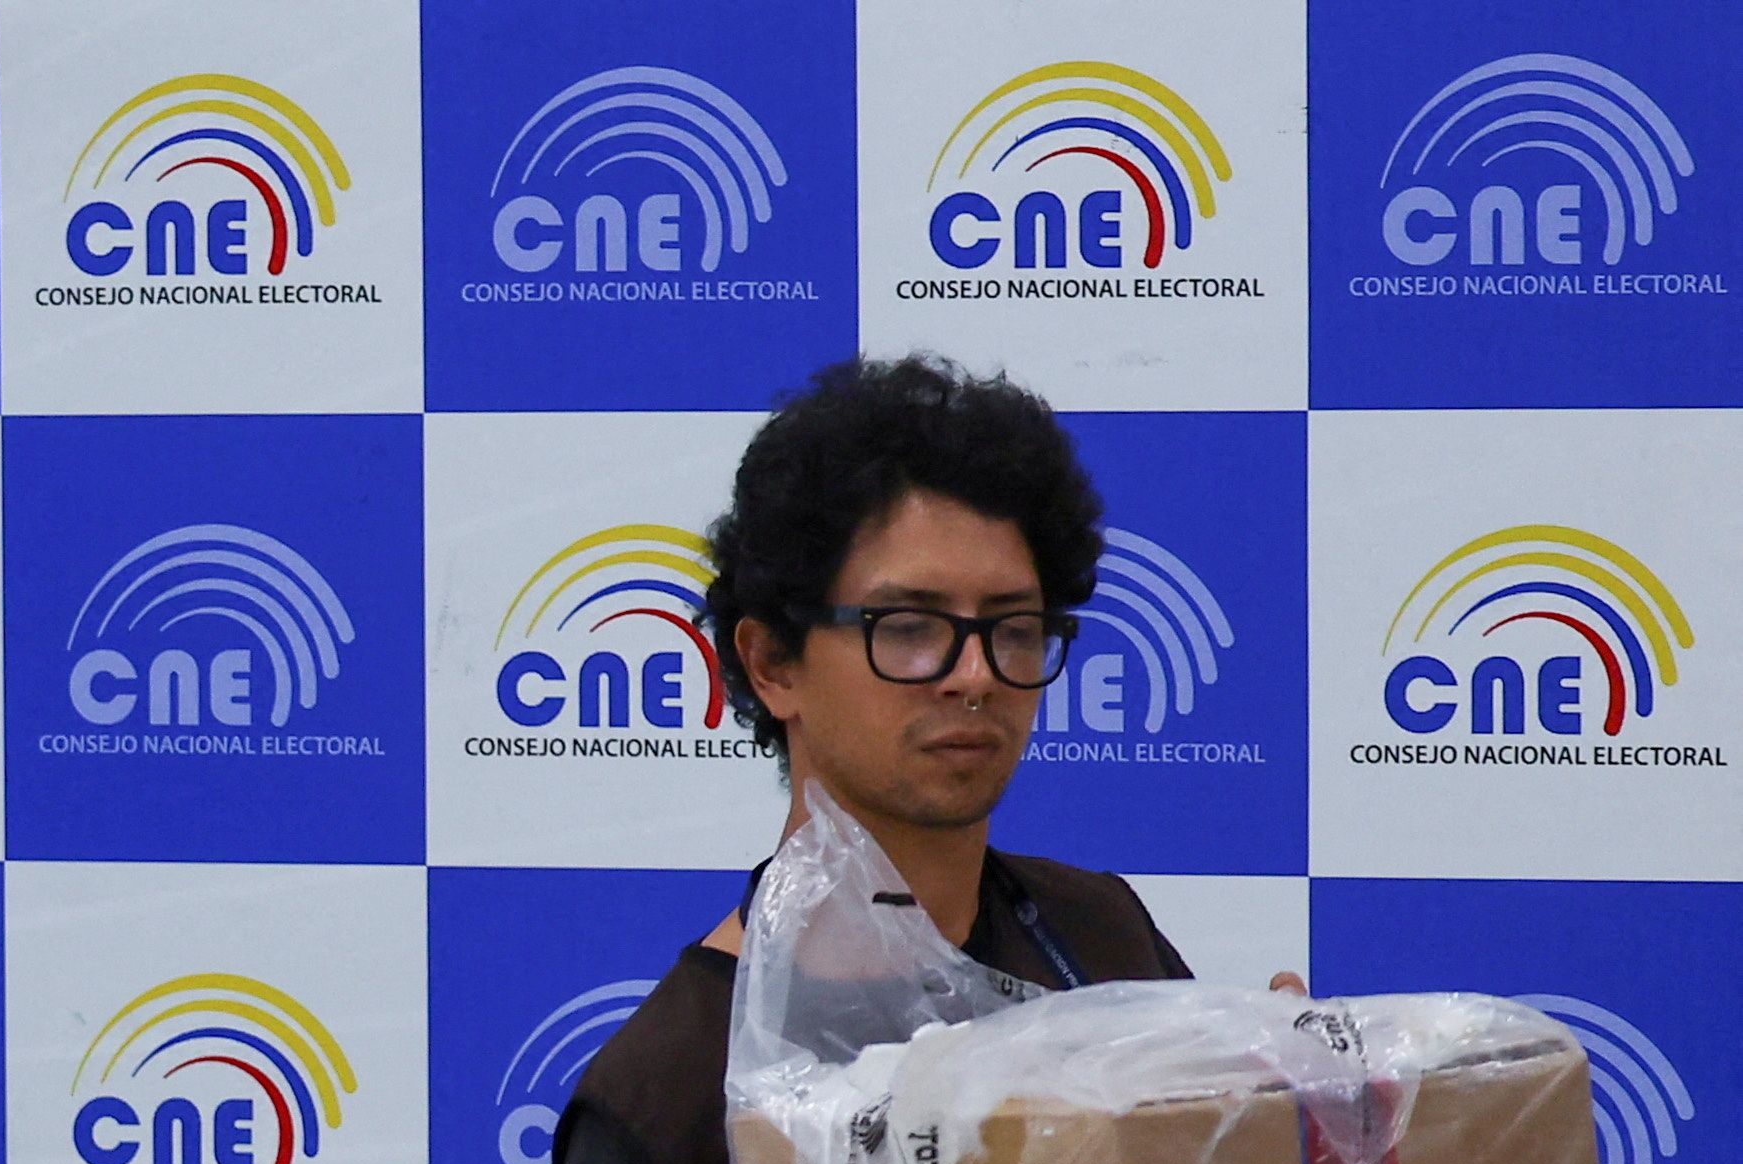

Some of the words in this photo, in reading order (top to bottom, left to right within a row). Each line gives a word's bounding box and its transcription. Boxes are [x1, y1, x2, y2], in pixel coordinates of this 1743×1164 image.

[492, 193, 682, 273] CNE
[928, 190, 1123, 270] CNE
[1382, 184, 1582, 266] CNE
[65, 199, 248, 277] CNE
[35, 286, 134, 306] CONSEJO
[140, 285, 253, 305] NACIONAL
[258, 284, 382, 304] ELECTORAL
[460, 282, 564, 303] CONSEJO
[569, 281, 686, 301] NACIONAL
[691, 281, 820, 301] ELECTORAL
[896, 279, 1001, 300] CONSEJO
[1007, 279, 1128, 299] NACIONAL
[1134, 278, 1265, 298] ELECTORAL
[1349, 276, 1457, 297] CONSEJO
[1463, 275, 1588, 296] NACIONAL
[1593, 273, 1728, 295] ELECTORAL
[69, 649, 252, 726] CNE
[496, 650, 684, 729] CNE
[1383, 655, 1582, 736] CNE
[38, 734, 138, 754] CONSEJO
[143, 735, 256, 755] NACIONAL
[261, 735, 386, 756] ELECTORAL
[464, 737, 566, 757] CONSEJO
[572, 738, 689, 758] NACIONAL
[694, 739, 777, 759] ELECTO
[1021, 742, 1130, 762] ACIONAL
[1135, 743, 1266, 763] ELECTORAL
[1350, 744, 1458, 765] CONSEJO
[1464, 745, 1588, 766] NACIONAL
[1593, 746, 1728, 767] ELECTORAL
